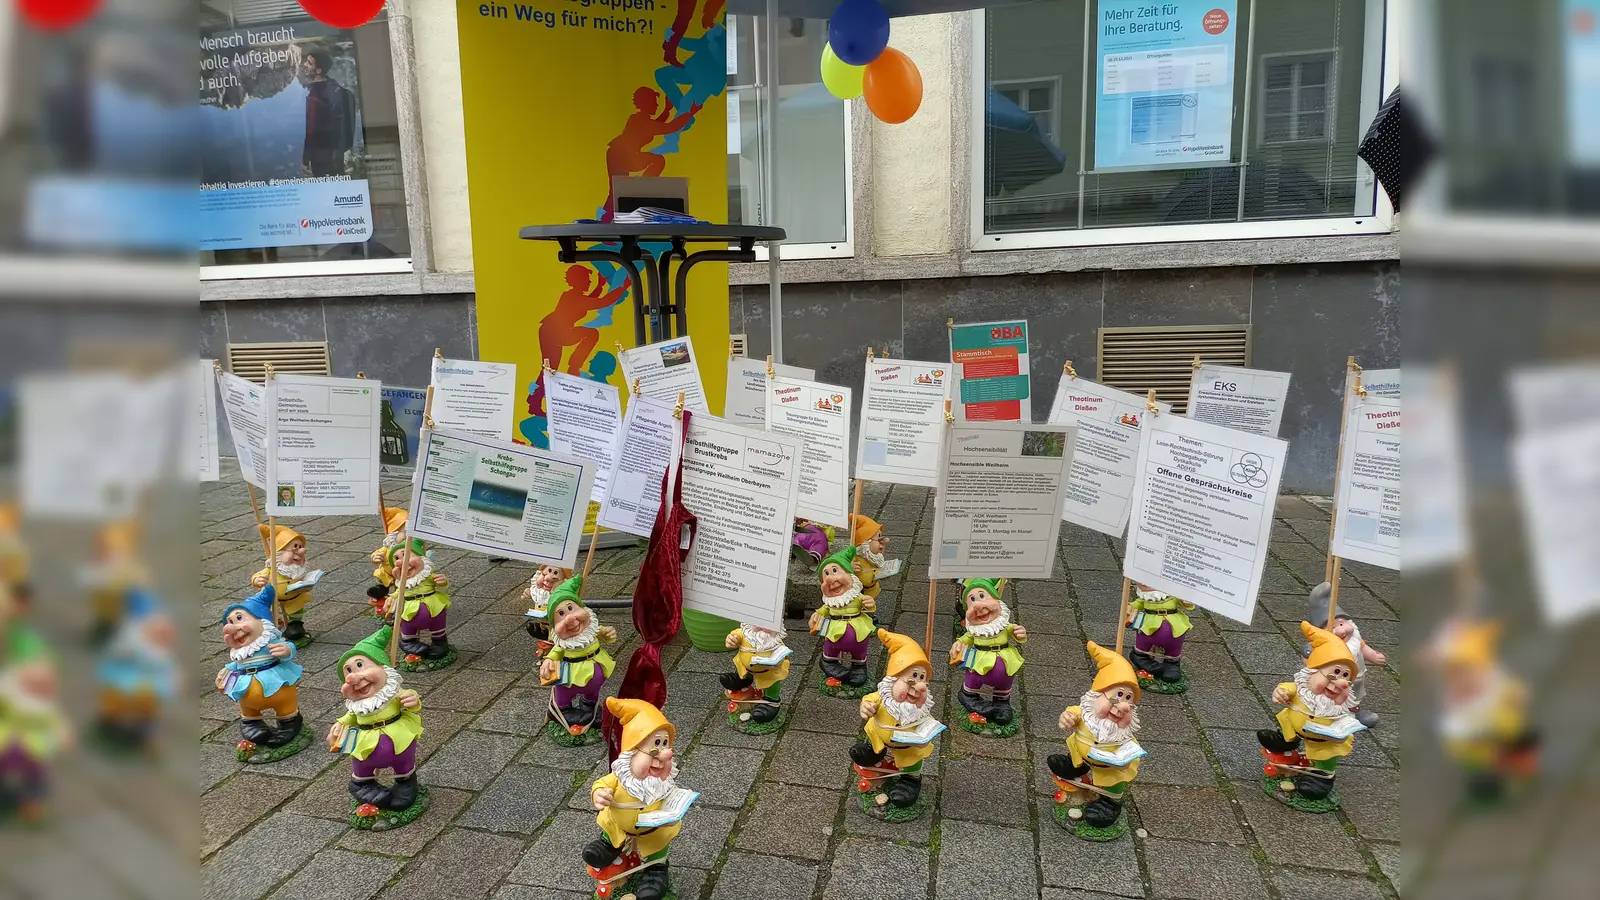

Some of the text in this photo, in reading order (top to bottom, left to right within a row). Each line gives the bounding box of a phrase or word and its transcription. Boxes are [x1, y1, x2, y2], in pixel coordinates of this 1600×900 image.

[479, 2, 507, 18] ein
[514, 4, 555, 28] Weg
[562, 10, 587, 27] für
[594, 16, 653, 35] mich?!
[1105, 4, 1178, 21] Mehr Zeit für
[1104, 20, 1183, 36] Ihre Beratung.
[200, 26, 296, 51] Mensch braucht
[208, 72, 241, 90] auch.
[268, 173, 352, 188] #gemeinsamverändern
[334, 194, 363, 203] Amundi
[308, 216, 365, 228] HypoVereinsbank
[874, 366, 902, 374] Theotinum
[774, 386, 802, 395] Theotinum
[1214, 381, 1236, 392] EKS
[1077, 420, 1104, 432] Trauergruppe
[686, 437, 739, 455] Selbsthilfegruppe
[1178, 436, 1204, 448] Themen:
[496, 454, 514, 462] Krebs-
[694, 448, 728, 461] Brustkrebs
[747, 447, 790, 460] mamazone
[1170, 449, 1208, 464] Hochbegabung
[480, 458, 528, 473] Selbsthilfegruppe
[682, 458, 708, 468] amazone
[490, 467, 516, 478] Schongau
[717, 472, 740, 482] Weilheim
[740, 477, 771, 489] Oberbayern
[1156, 467, 1252, 500] Offene Gesprächskreise
[714, 542, 736, 552] Weilheim
[744, 542, 776, 556] Theatergasse
[742, 562, 757, 570] Monat
